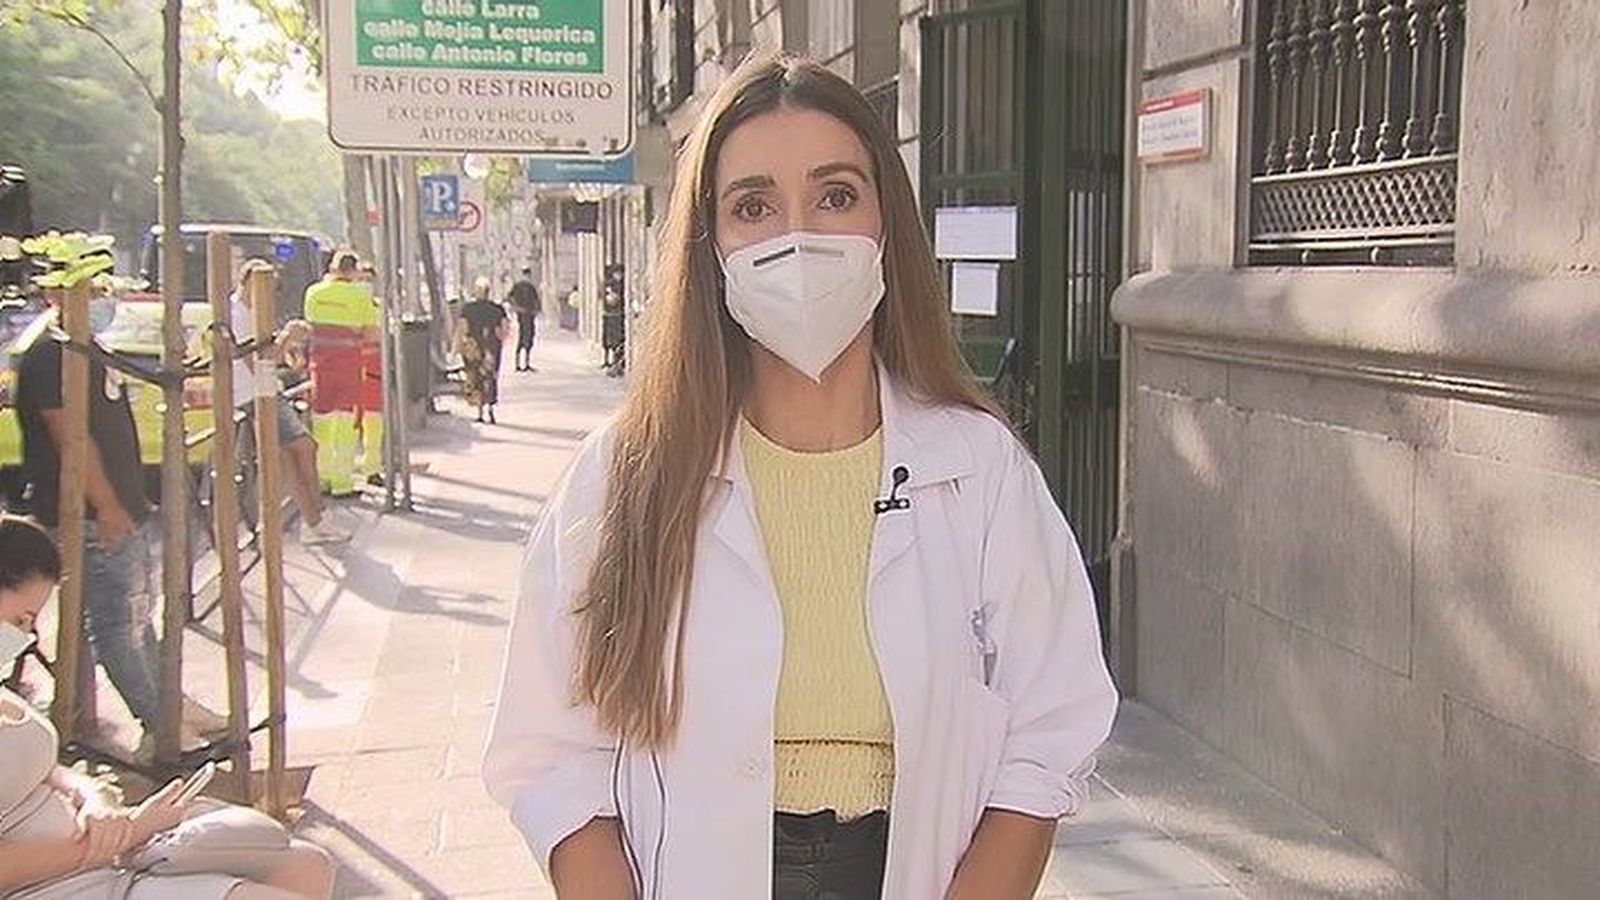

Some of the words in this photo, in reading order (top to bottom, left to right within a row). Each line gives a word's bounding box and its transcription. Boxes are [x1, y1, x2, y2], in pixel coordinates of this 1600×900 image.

[422, 0, 475, 17] calle
[482, 0, 540, 20] Larra
[364, 20, 418, 39] calle
[489, 24, 596, 44] Lequerica
[372, 43, 427, 61] calle
[432, 44, 516, 63] Antonio
[522, 47, 588, 65] Flores
[458, 79, 613, 100] RESTRINGIDO
[387, 106, 469, 121] EXCEPTO
[419, 127, 545, 143] AUTORIZADOS
